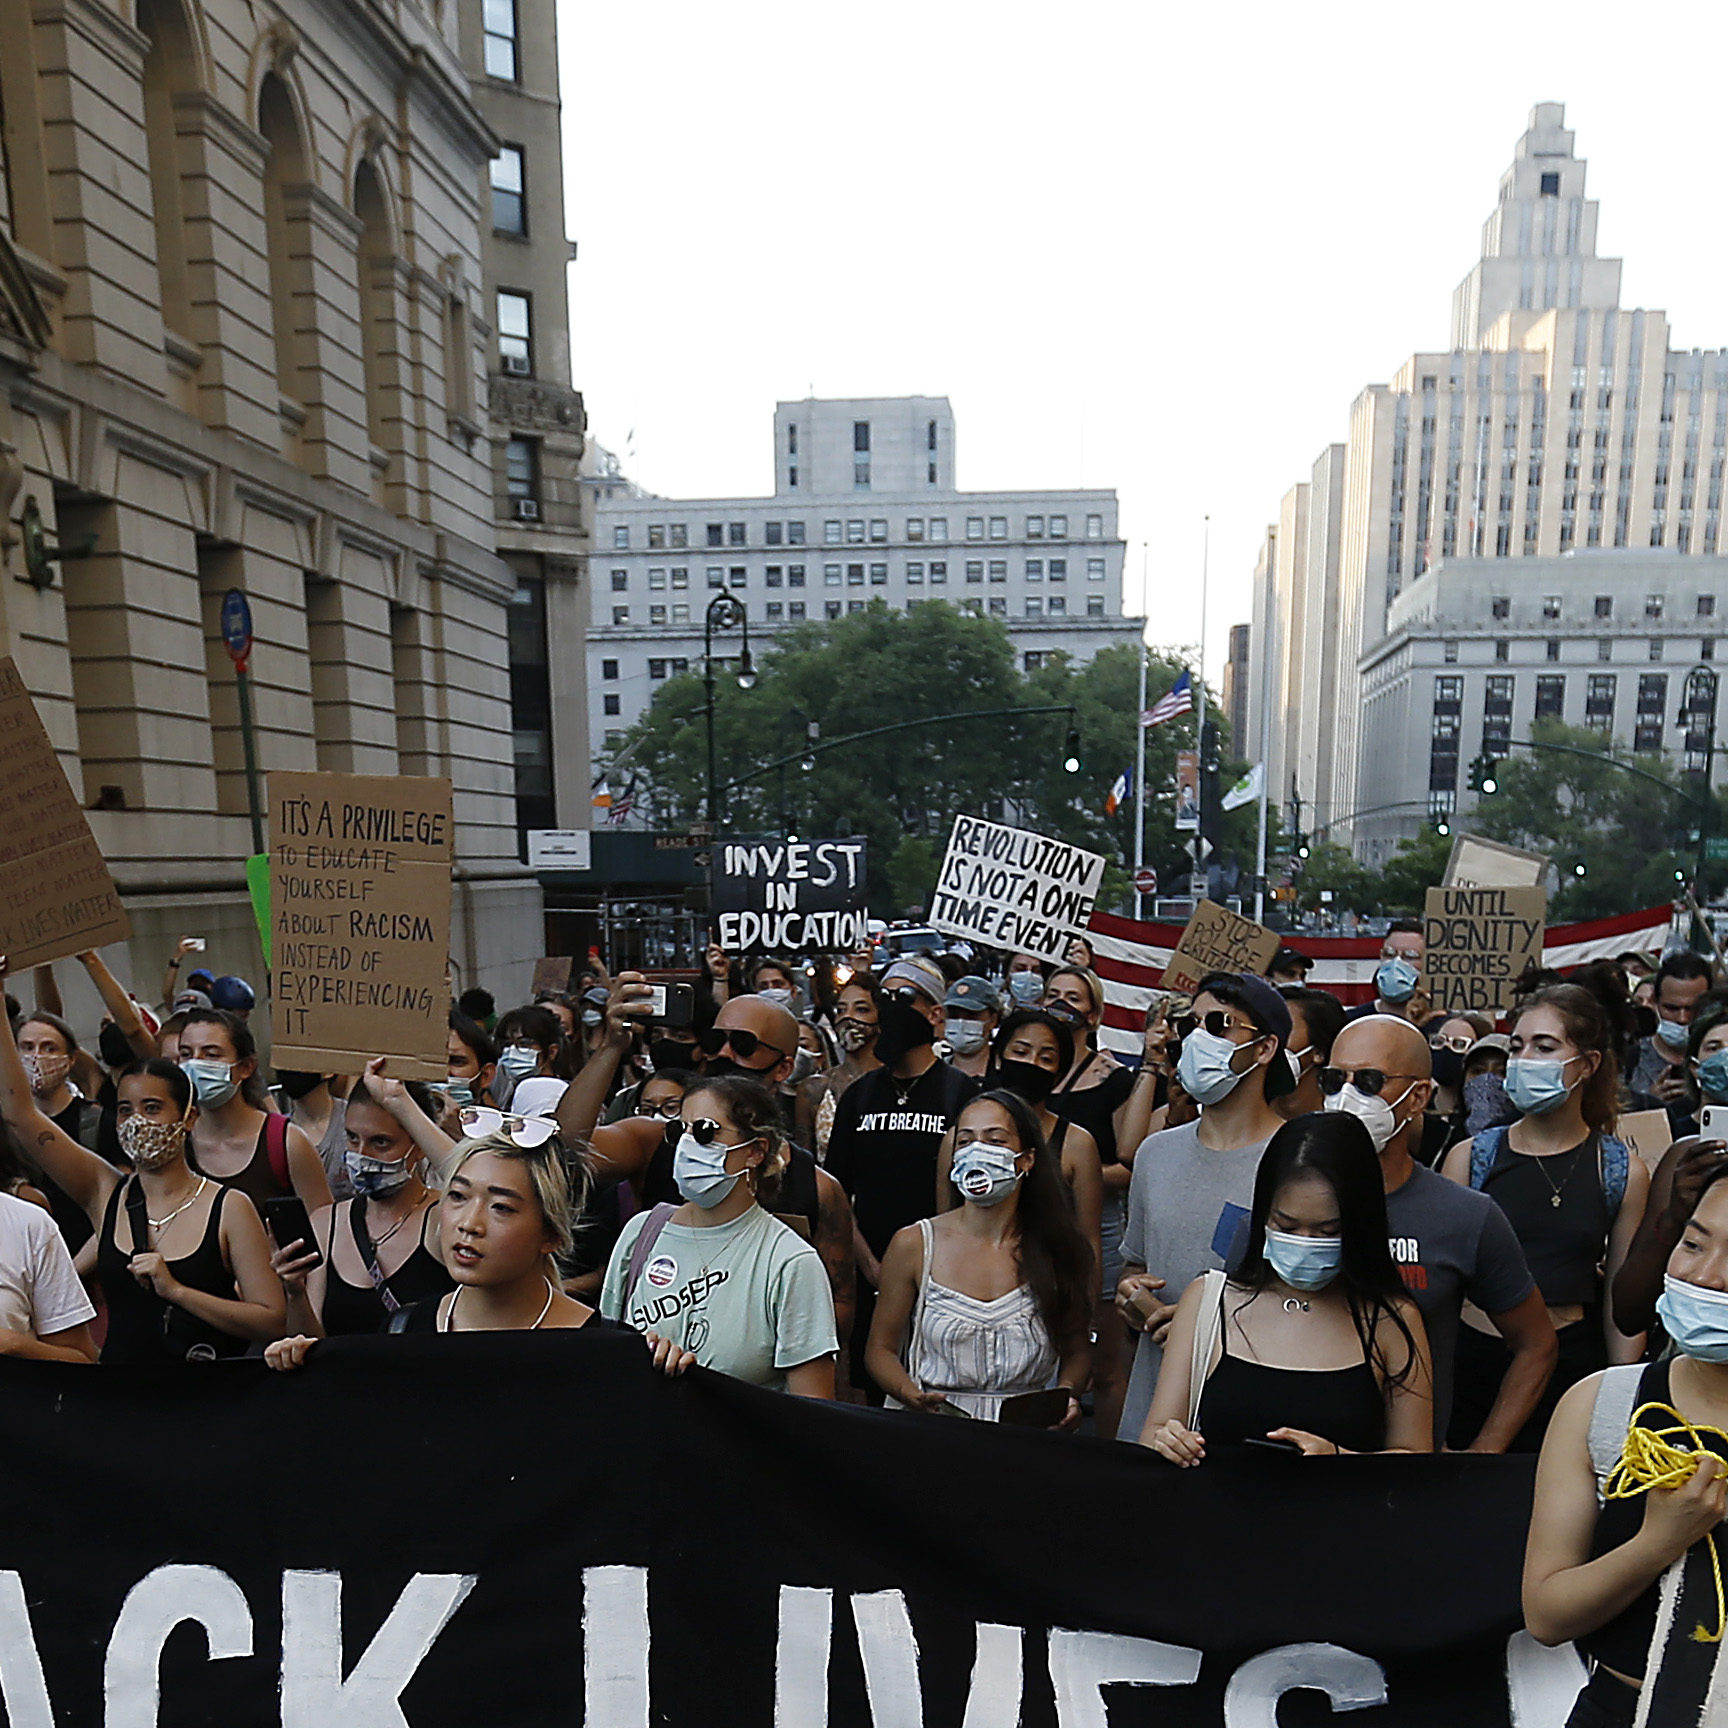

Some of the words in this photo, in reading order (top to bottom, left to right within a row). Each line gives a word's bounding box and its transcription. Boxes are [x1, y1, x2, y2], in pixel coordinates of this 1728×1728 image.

[281, 794, 311, 836] IT'S
[316, 801, 333, 838] A
[343, 804, 446, 845] PRIVILEGE
[277, 844, 297, 866] TO
[307, 845, 397, 873] EDUCATE
[725, 844, 862, 888] INVEST
[953, 818, 1096, 886] REVOLUTION
[278, 875, 374, 903] YOURSELF
[766, 882, 797, 911] IN
[942, 856, 969, 891] IS
[967, 863, 1025, 902] NOT
[1017, 879, 1039, 912] A
[1041, 884, 1095, 929] ONE
[1444, 890, 1515, 916] UNTIL
[19, 909, 62, 940] LIVES
[61, 891, 118, 924] MATTER
[278, 910, 343, 936] ABOUT
[350, 910, 434, 942] RACISM
[719, 907, 869, 951] EDUCATION
[936, 892, 999, 935] TIME
[996, 911, 1081, 962] EVENT
[1212, 909, 1263, 945] STOP
[1191, 922, 1263, 971] POLICE
[1425, 918, 1540, 953] DIGNITY
[281, 943, 351, 971] INSTEAD
[361, 951, 384, 972] OF
[1426, 953, 1511, 976] BECOMES
[279, 971, 434, 1018] EXPERIENCING
[286, 1007, 312, 1037] IT.
[889, 1112, 948, 1134] BREATHE.
[1388, 1237, 1419, 1263] FOR
